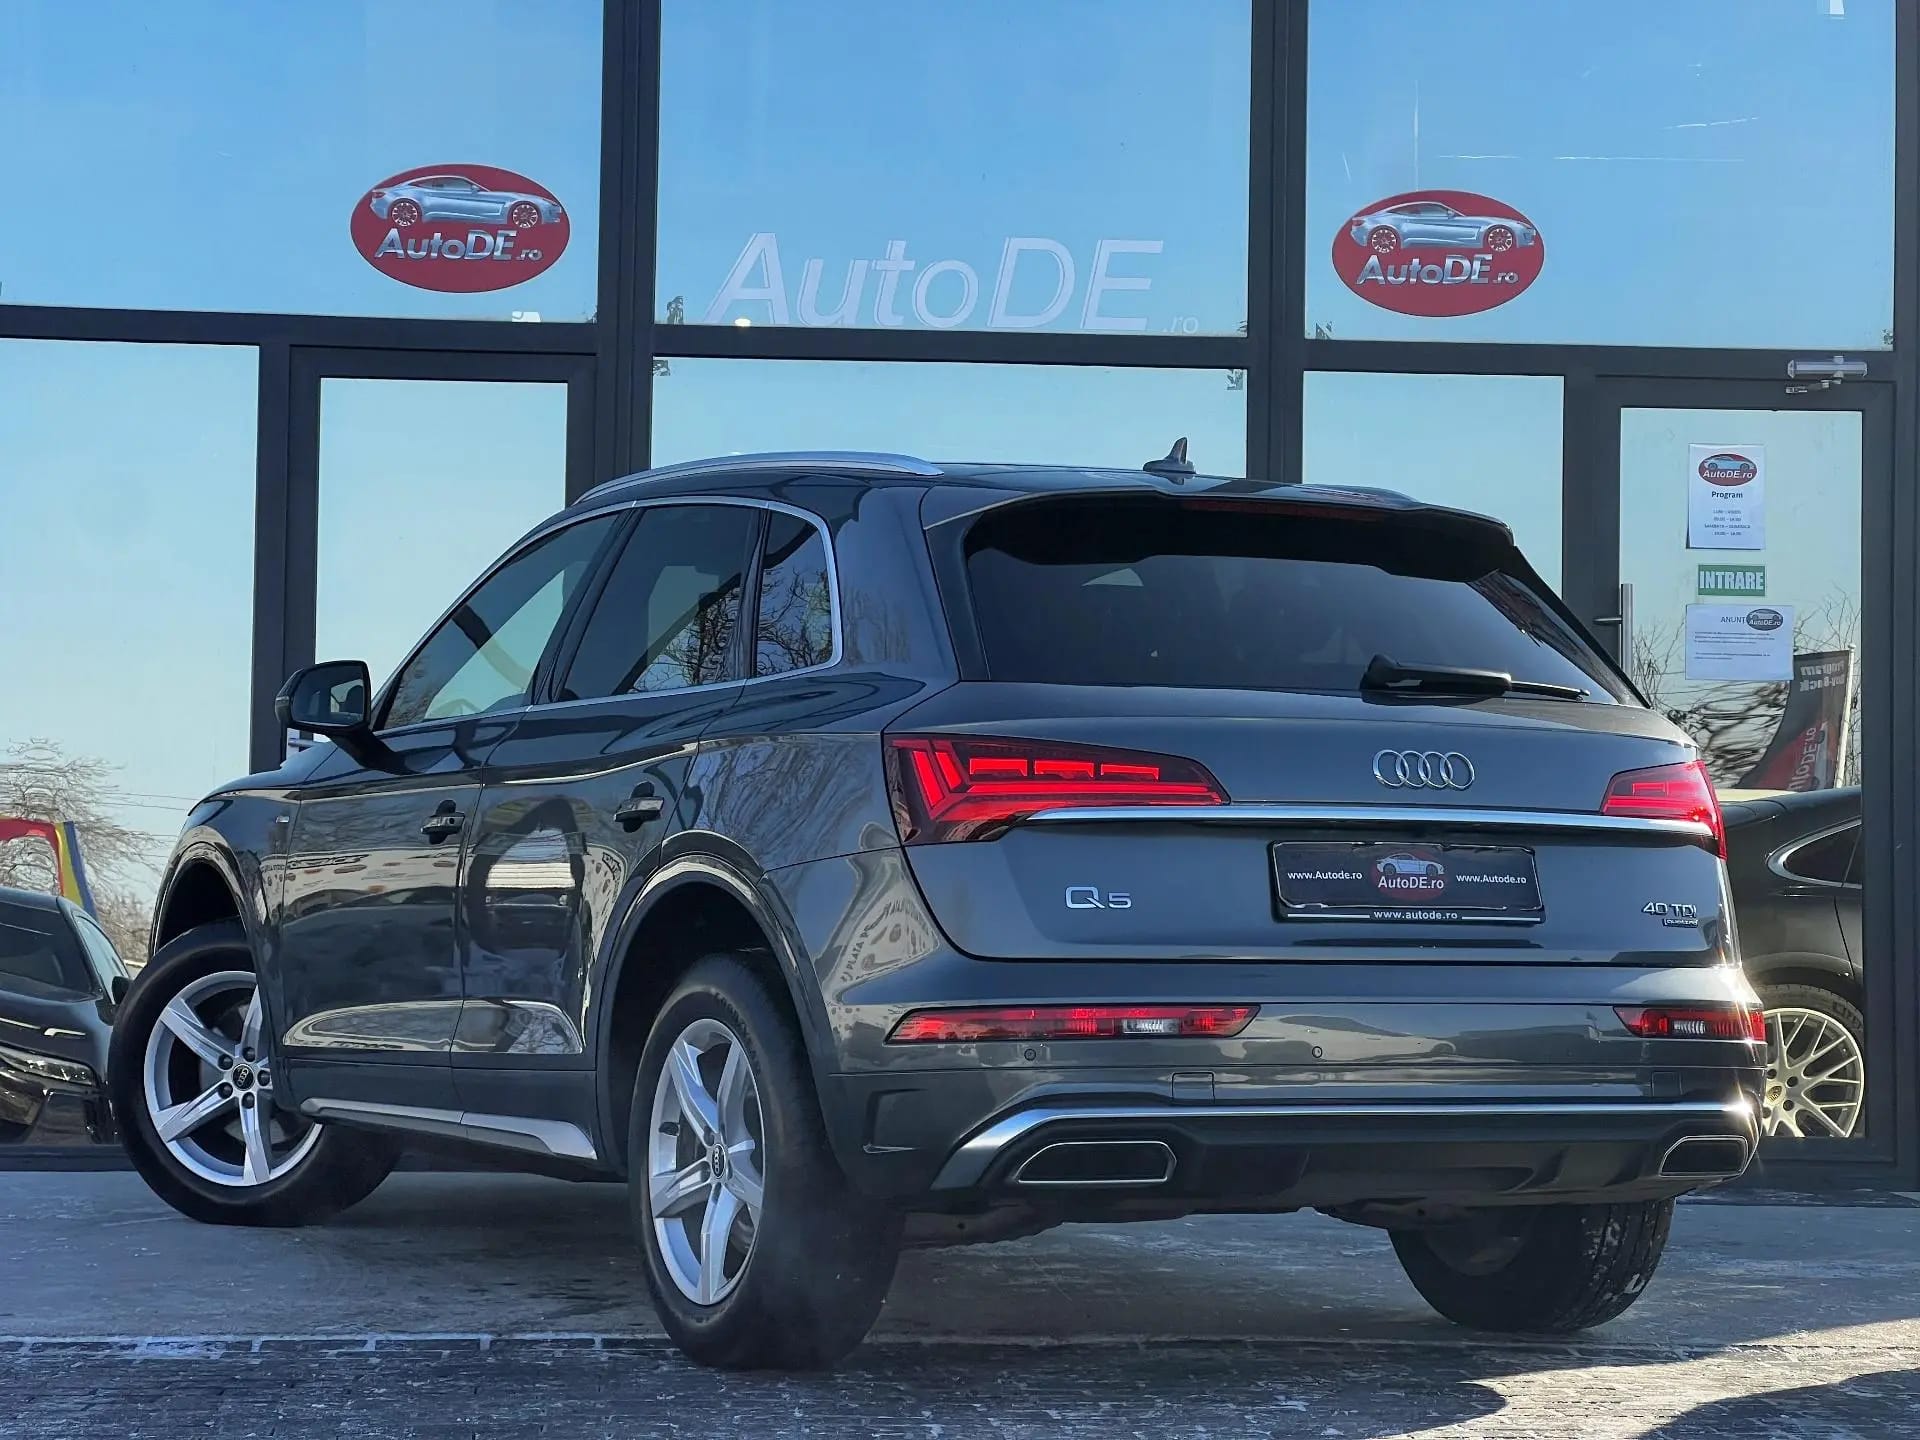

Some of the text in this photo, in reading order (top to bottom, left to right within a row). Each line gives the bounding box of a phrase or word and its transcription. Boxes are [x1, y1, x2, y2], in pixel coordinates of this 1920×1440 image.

[1702, 470, 1753, 479] AutoDE.ro
[1711, 491, 1743, 500] Program
[1700, 570, 1764, 590] INTRARE
[1287, 870, 1363, 880] www.Autode.ro
[1456, 873, 1527, 884] www.Autode.ro
[1378, 876, 1445, 889] AutoDE.ro
[1374, 910, 1458, 920] www.autode.ro
[1643, 902, 1697, 918] 40 TDI
